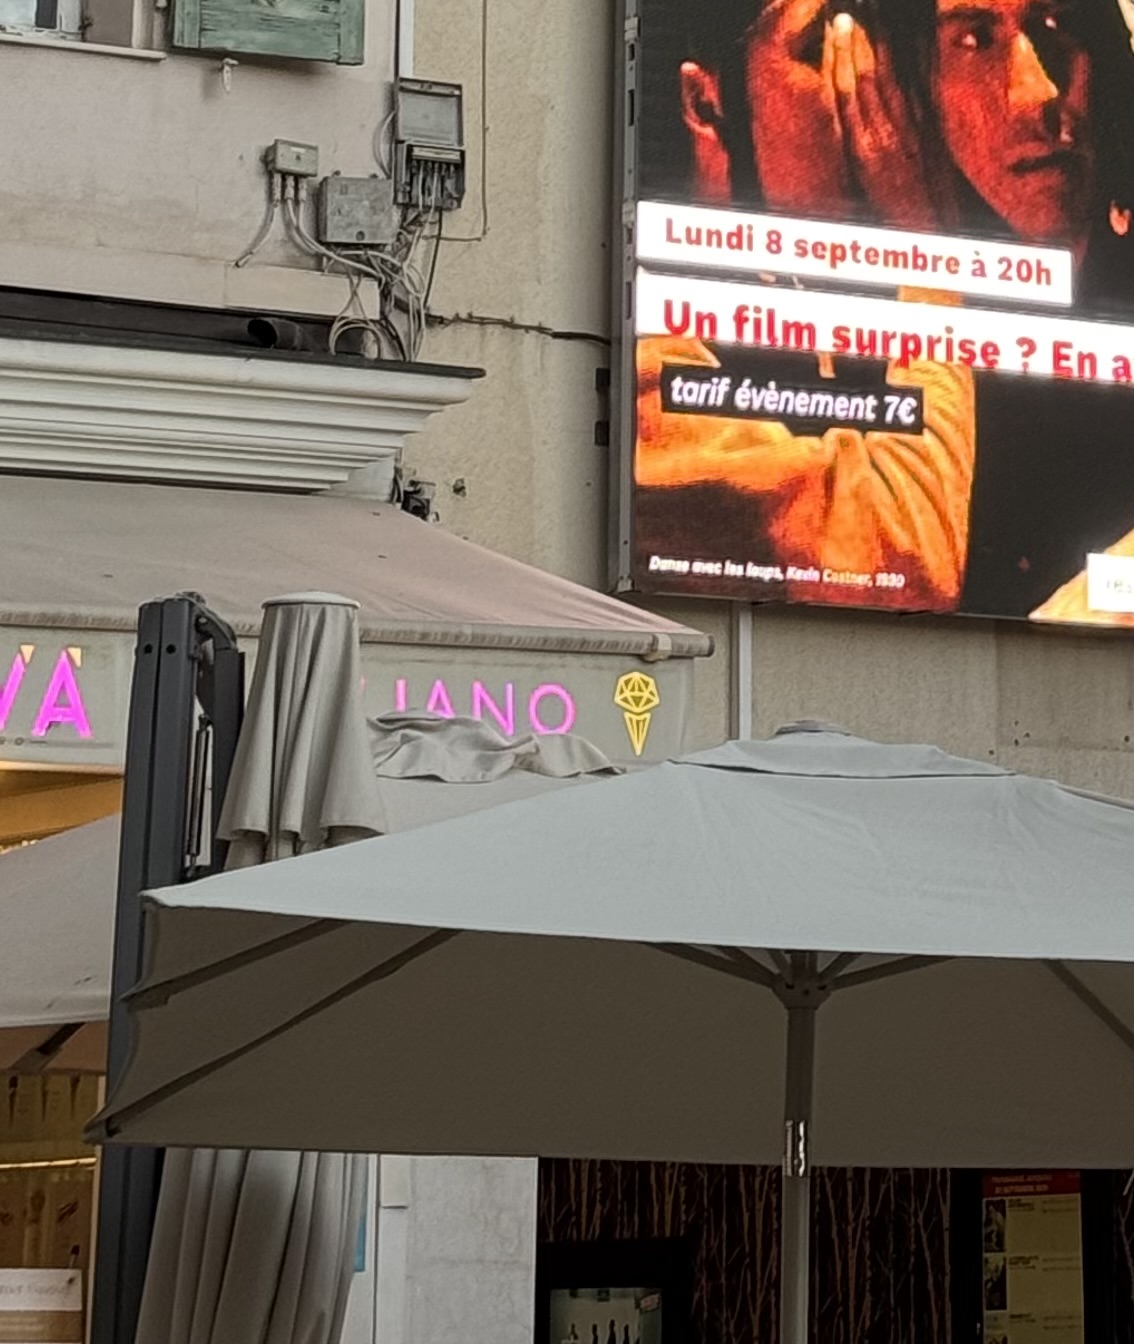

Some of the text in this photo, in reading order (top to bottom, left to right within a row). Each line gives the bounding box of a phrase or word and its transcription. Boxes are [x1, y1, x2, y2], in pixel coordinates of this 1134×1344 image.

[665, 218, 1052, 286] Lundi 8 septembre à 20h
[663, 300, 718, 340] Un
[733, 303, 817, 351] film
[832, 324, 1001, 368] surprise
[1016, 336, 1037, 374] ?
[1052, 340, 1097, 378] En
[671, 376, 918, 425] tarif évènement 7€
[649, 555, 690, 573] Danse
[691, 560, 722, 575] avec
[724, 560, 744, 577] les
[786, 564, 821, 583] Kevin
